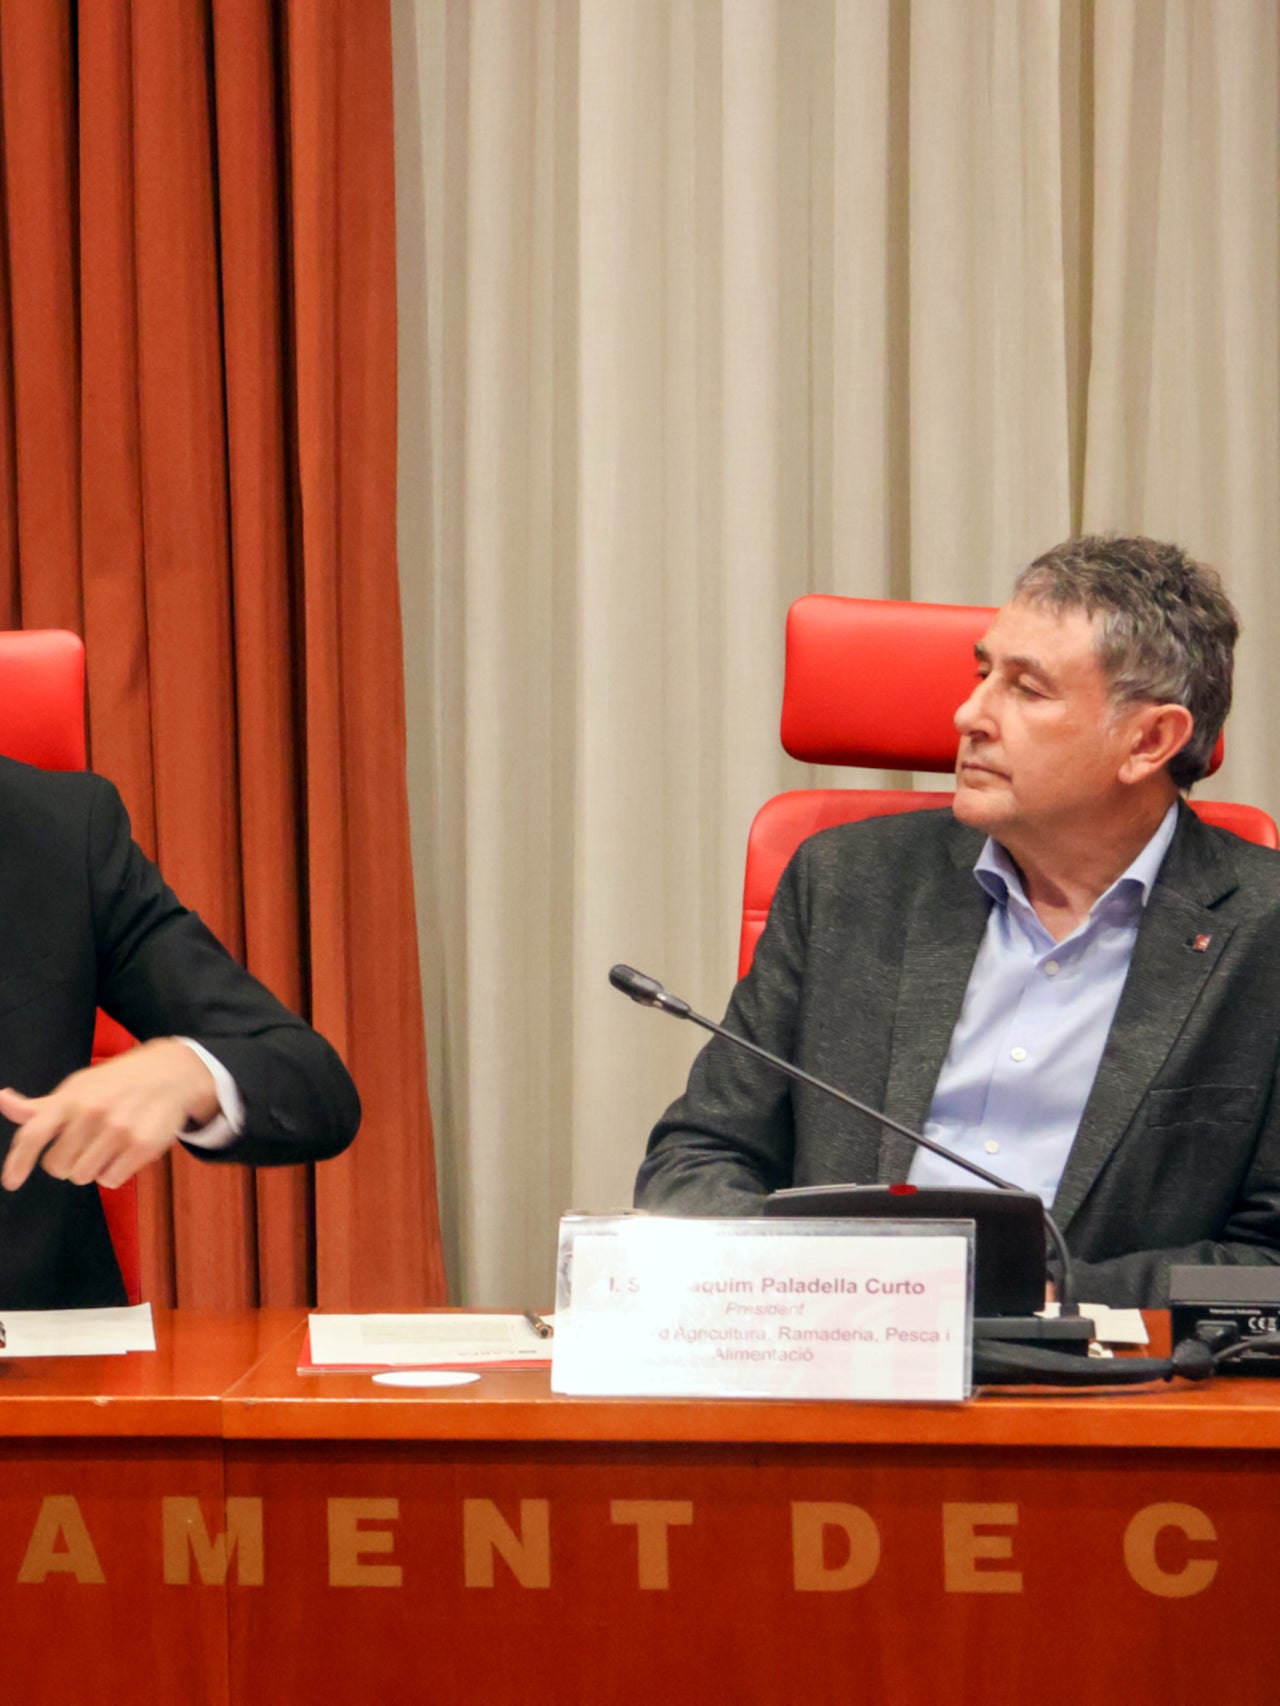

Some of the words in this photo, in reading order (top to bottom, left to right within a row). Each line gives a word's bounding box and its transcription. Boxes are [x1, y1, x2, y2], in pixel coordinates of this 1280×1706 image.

[688, 1277, 754, 1297] aquim
[761, 1277, 858, 1295] Paladella
[865, 1278, 926, 1295] Curto
[724, 1301, 805, 1317] President
[658, 1326, 772, 1345] dAgricultura,
[885, 1326, 940, 1343] Pesca
[945, 1326, 951, 1343] i
[714, 1346, 814, 1363] Alimentació
[791, 1500, 1024, 1593] DE
[1123, 1501, 1219, 1597] C
